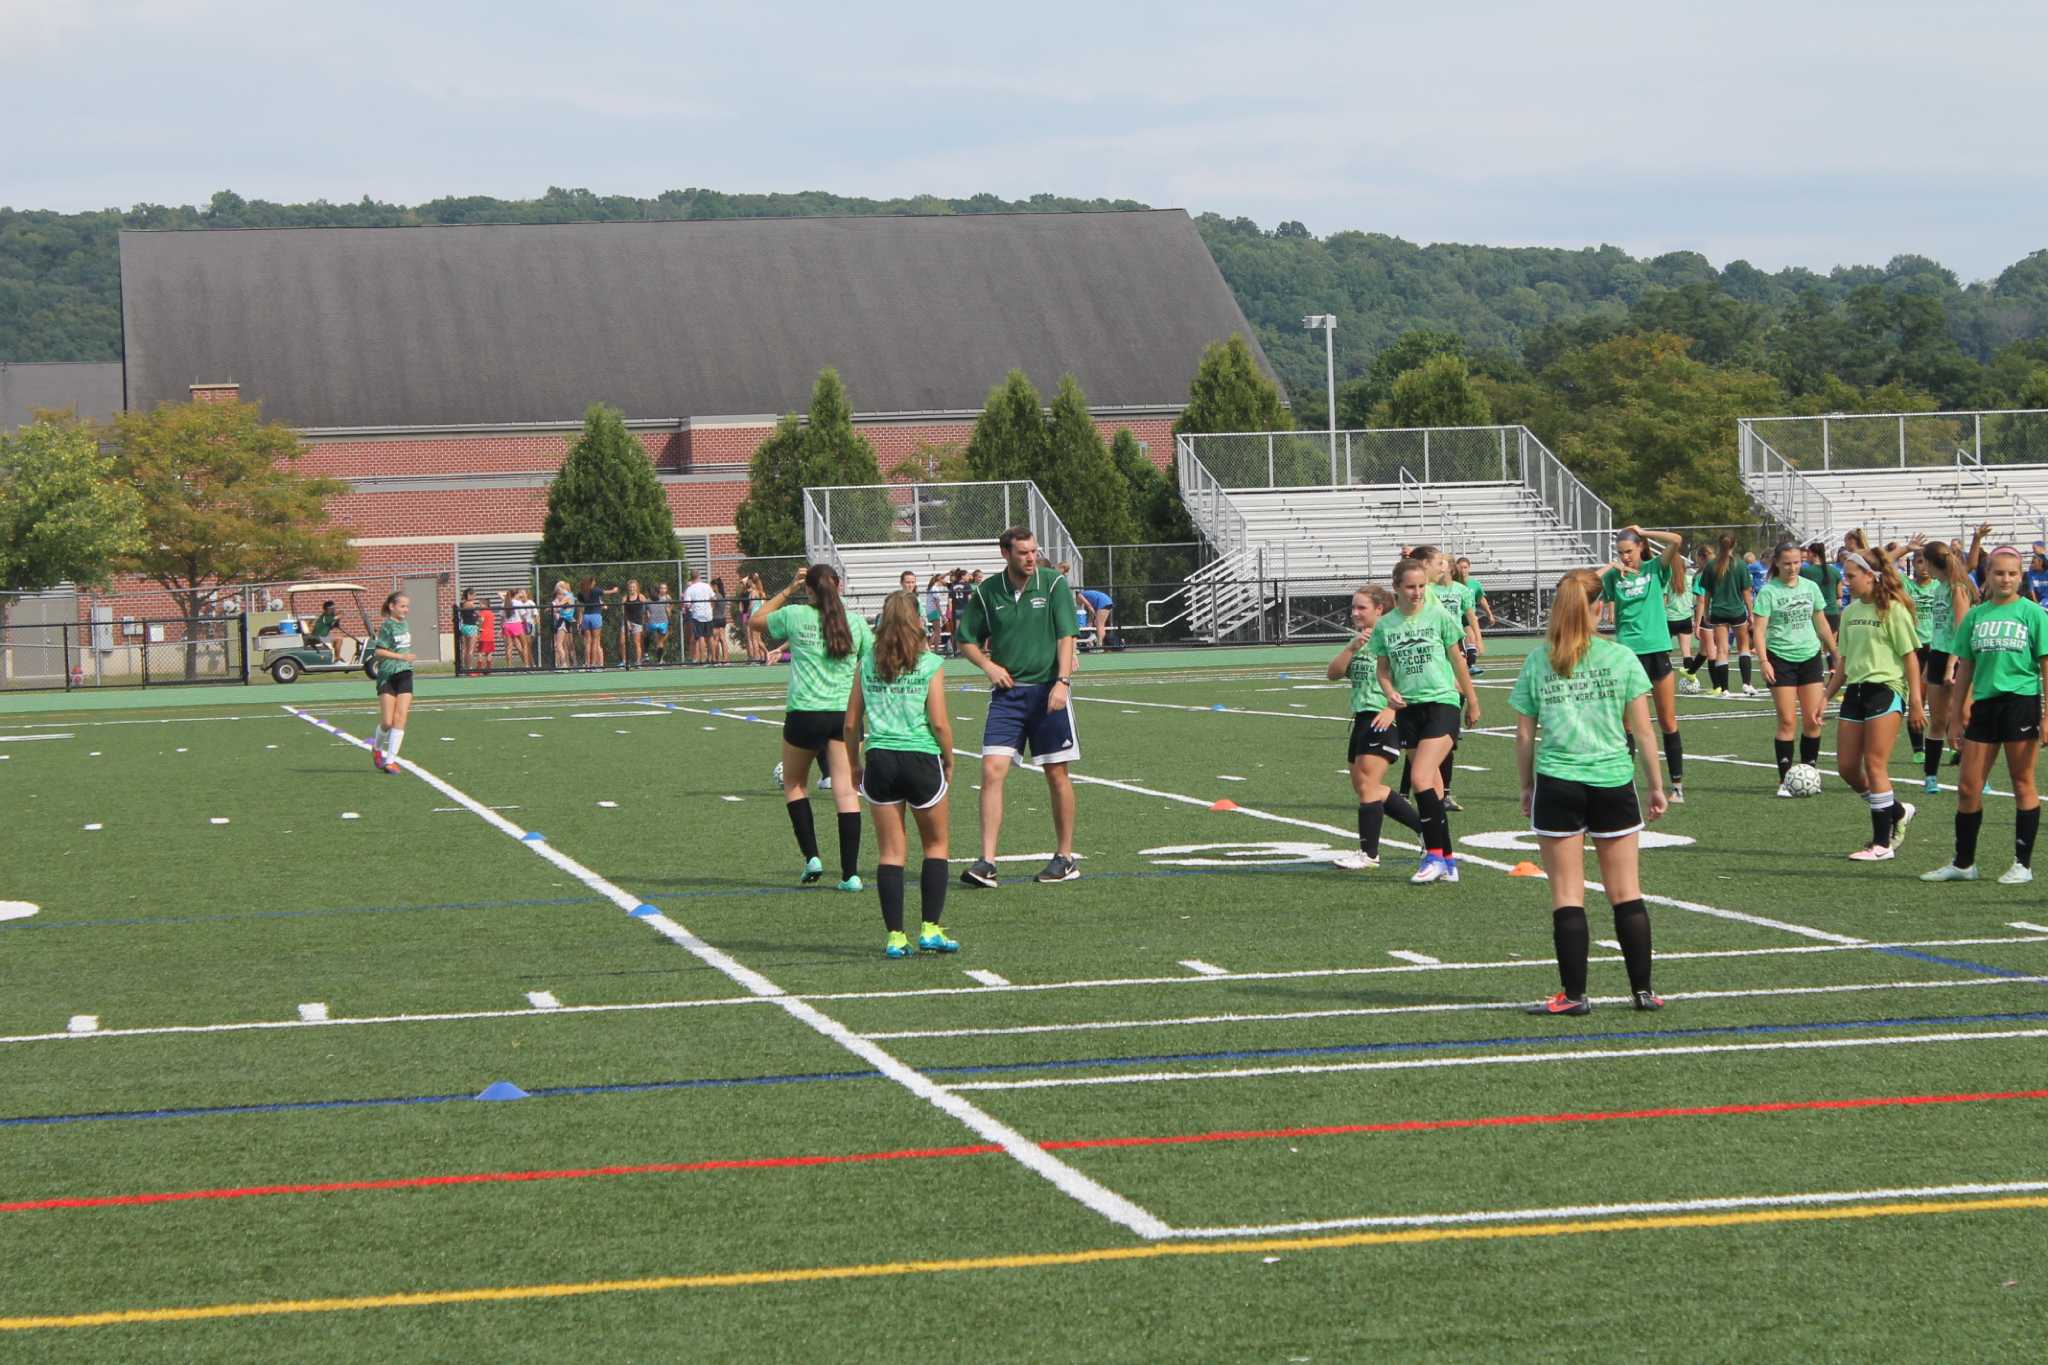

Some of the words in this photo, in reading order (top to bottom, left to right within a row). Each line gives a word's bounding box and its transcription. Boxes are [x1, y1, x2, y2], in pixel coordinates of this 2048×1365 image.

[1387, 632, 1401, 644] NEW
[1404, 627, 1434, 639] MILFORD
[1972, 620, 2028, 640] YOUTH
[1406, 665, 1424, 675] 2015
[1540, 685, 1564, 695] TALENT
[1568, 682, 1588, 690] WHEN
[1592, 679, 1617, 688] TALENT
